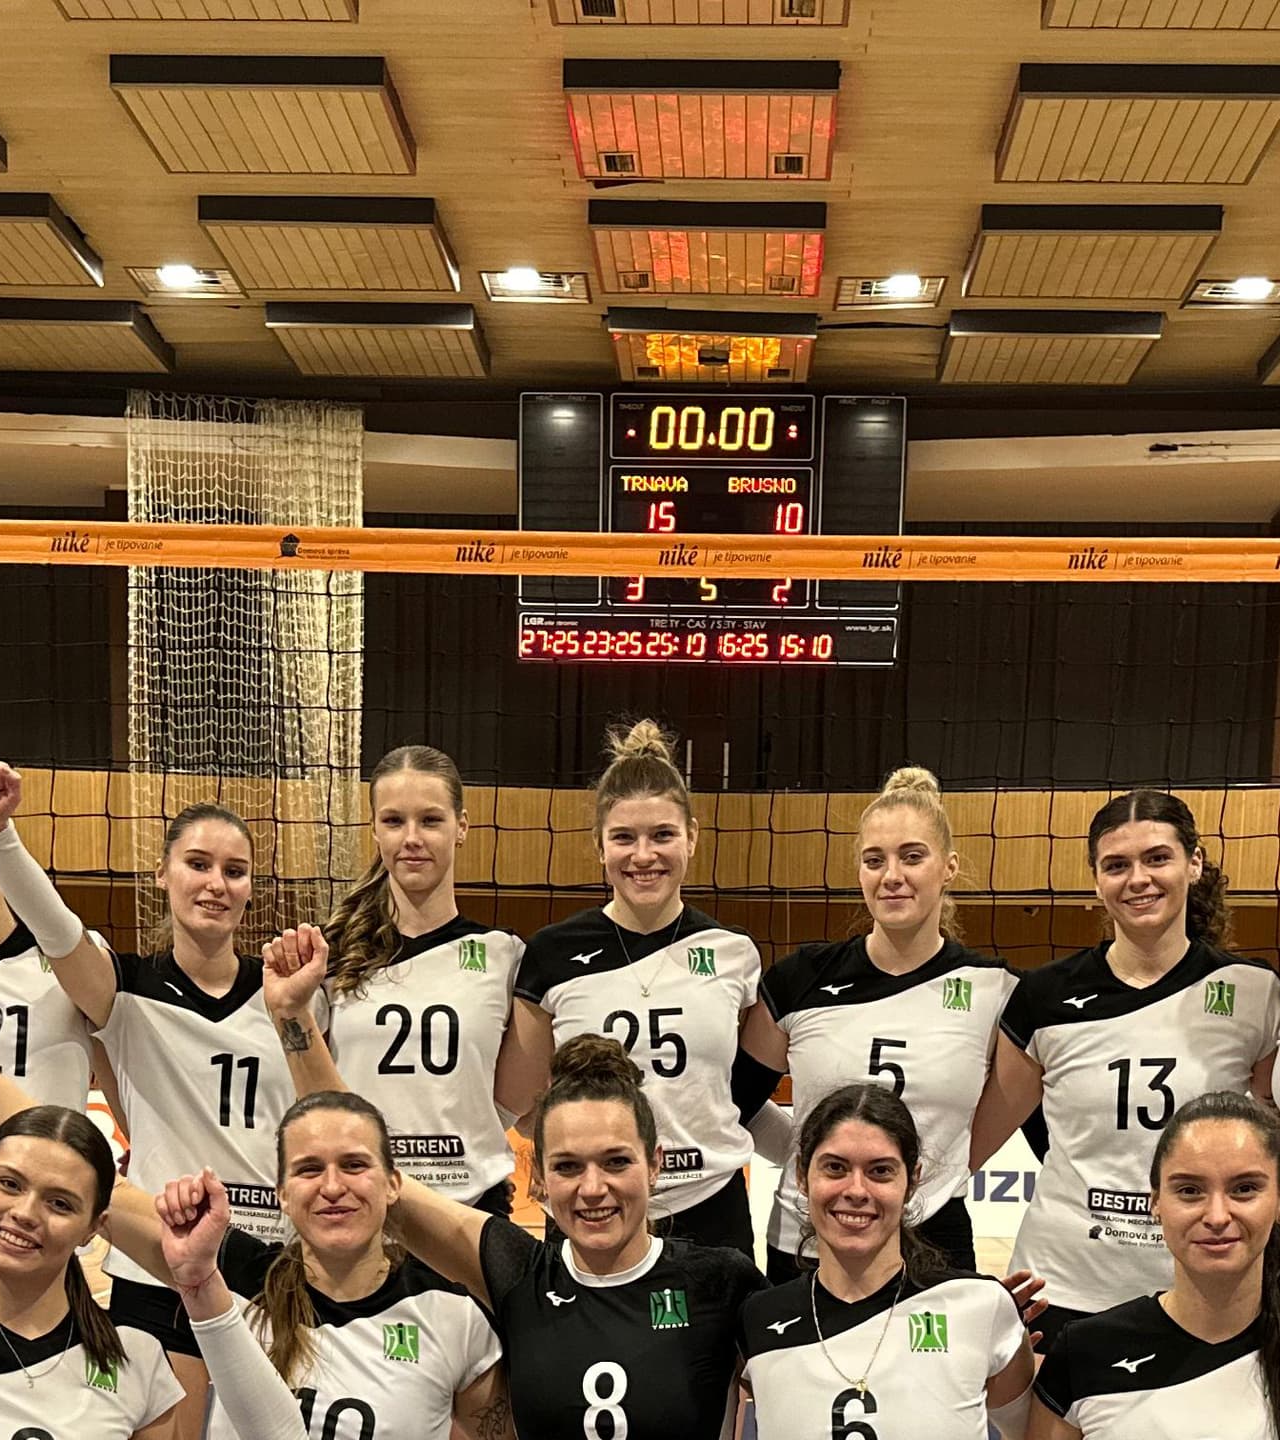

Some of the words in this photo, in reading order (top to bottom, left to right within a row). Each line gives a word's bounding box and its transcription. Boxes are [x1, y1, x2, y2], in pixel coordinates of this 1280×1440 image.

[621, 475, 688, 493] TRNAVA
[728, 477, 797, 494] BRUSNO
[648, 501, 676, 532] 15
[775, 502, 803, 532] 10
[51, 530, 90, 553] niké
[117, 539, 163, 551] tipovanie
[455, 540, 495, 562] niké
[522, 548, 568, 561] tipovanie
[658, 543, 698, 566] niké
[725, 551, 771, 564] tipovanie
[862, 545, 902, 568] niké
[930, 552, 976, 565] tipovanie
[1068, 547, 1108, 570] niké
[1136, 555, 1183, 567] tipovanie
[743, 621, 767, 630] STAV
[521, 631, 580, 655] 27:25
[583, 631, 642, 655] 23:25
[376, 1003, 460, 1076] 20
[603, 1007, 688, 1078] 25
[868, 1037, 907, 1099] 5
[210, 1053, 260, 1129] 11
[1107, 1058, 1177, 1131] 13
[389, 1138, 460, 1155] ESTRENT
[435, 1171, 470, 1183] správa
[1091, 1191, 1152, 1212] BESTR
